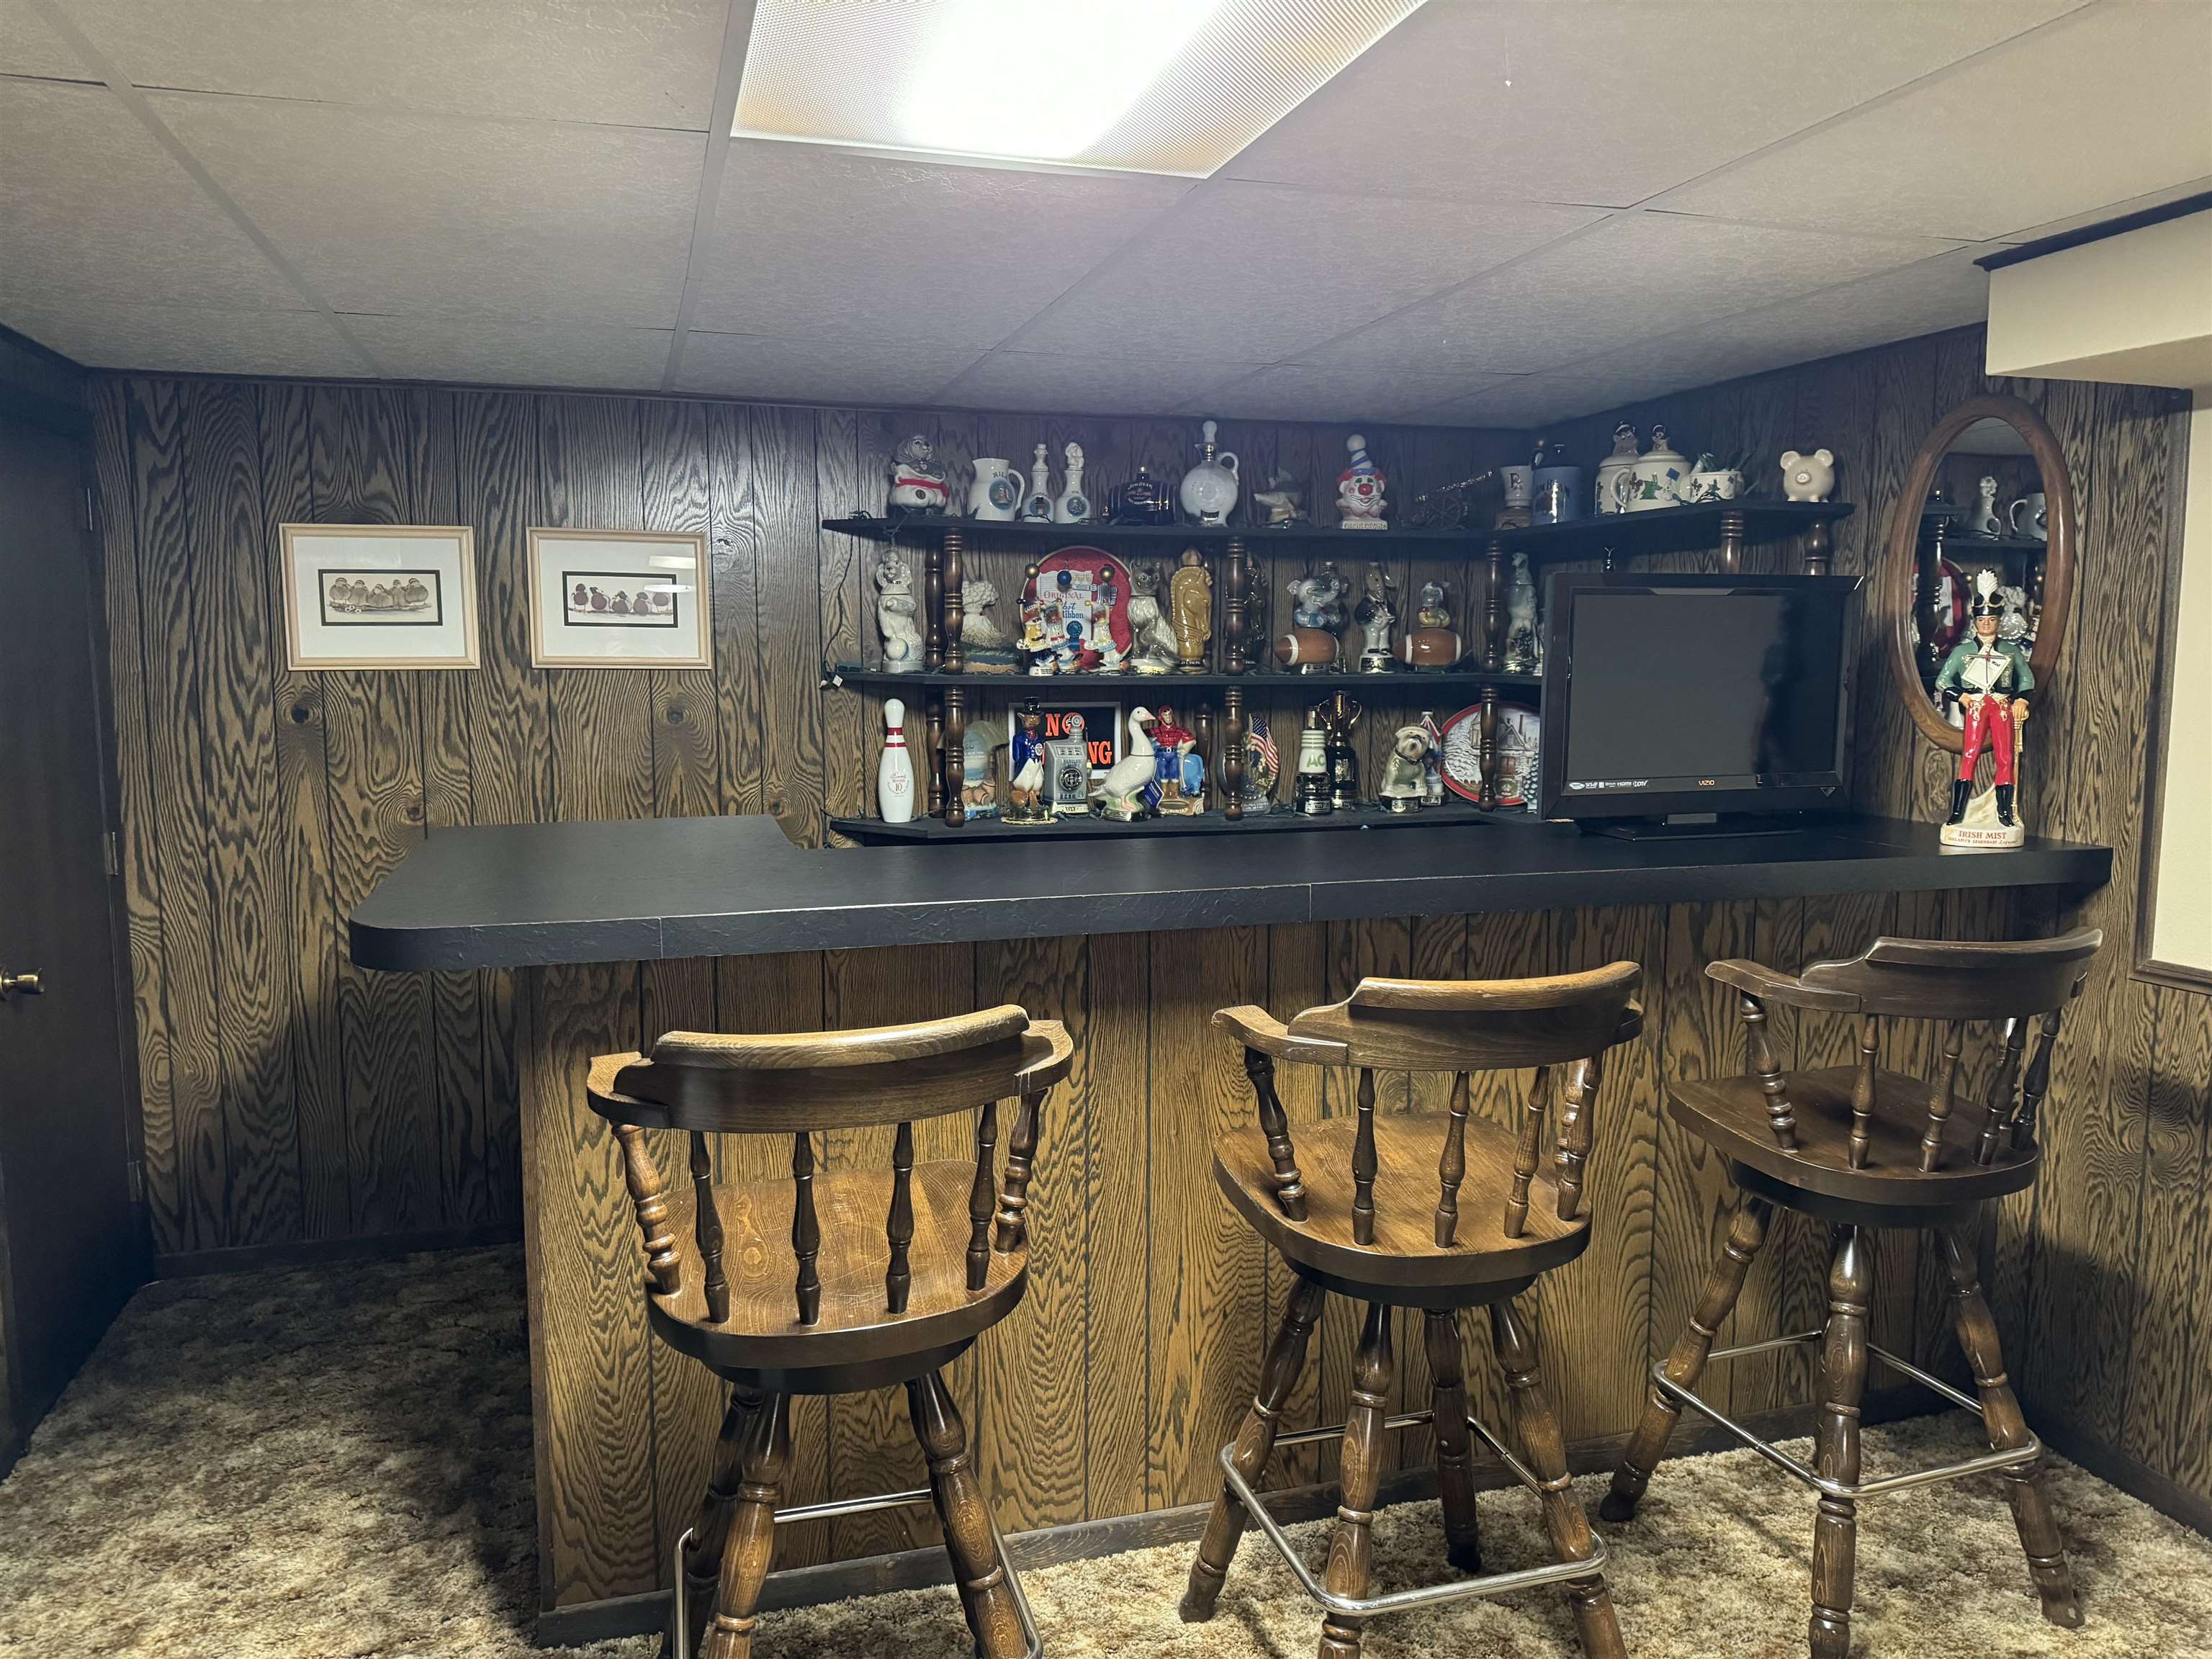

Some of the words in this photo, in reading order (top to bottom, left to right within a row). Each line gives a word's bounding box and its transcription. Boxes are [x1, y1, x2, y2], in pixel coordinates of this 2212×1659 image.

[1043, 591, 1084, 600] ORIGINAL
[1045, 712, 1085, 737] NO
[1307, 754, 1325, 768] AC
[1959, 830, 1982, 839] IRISH
